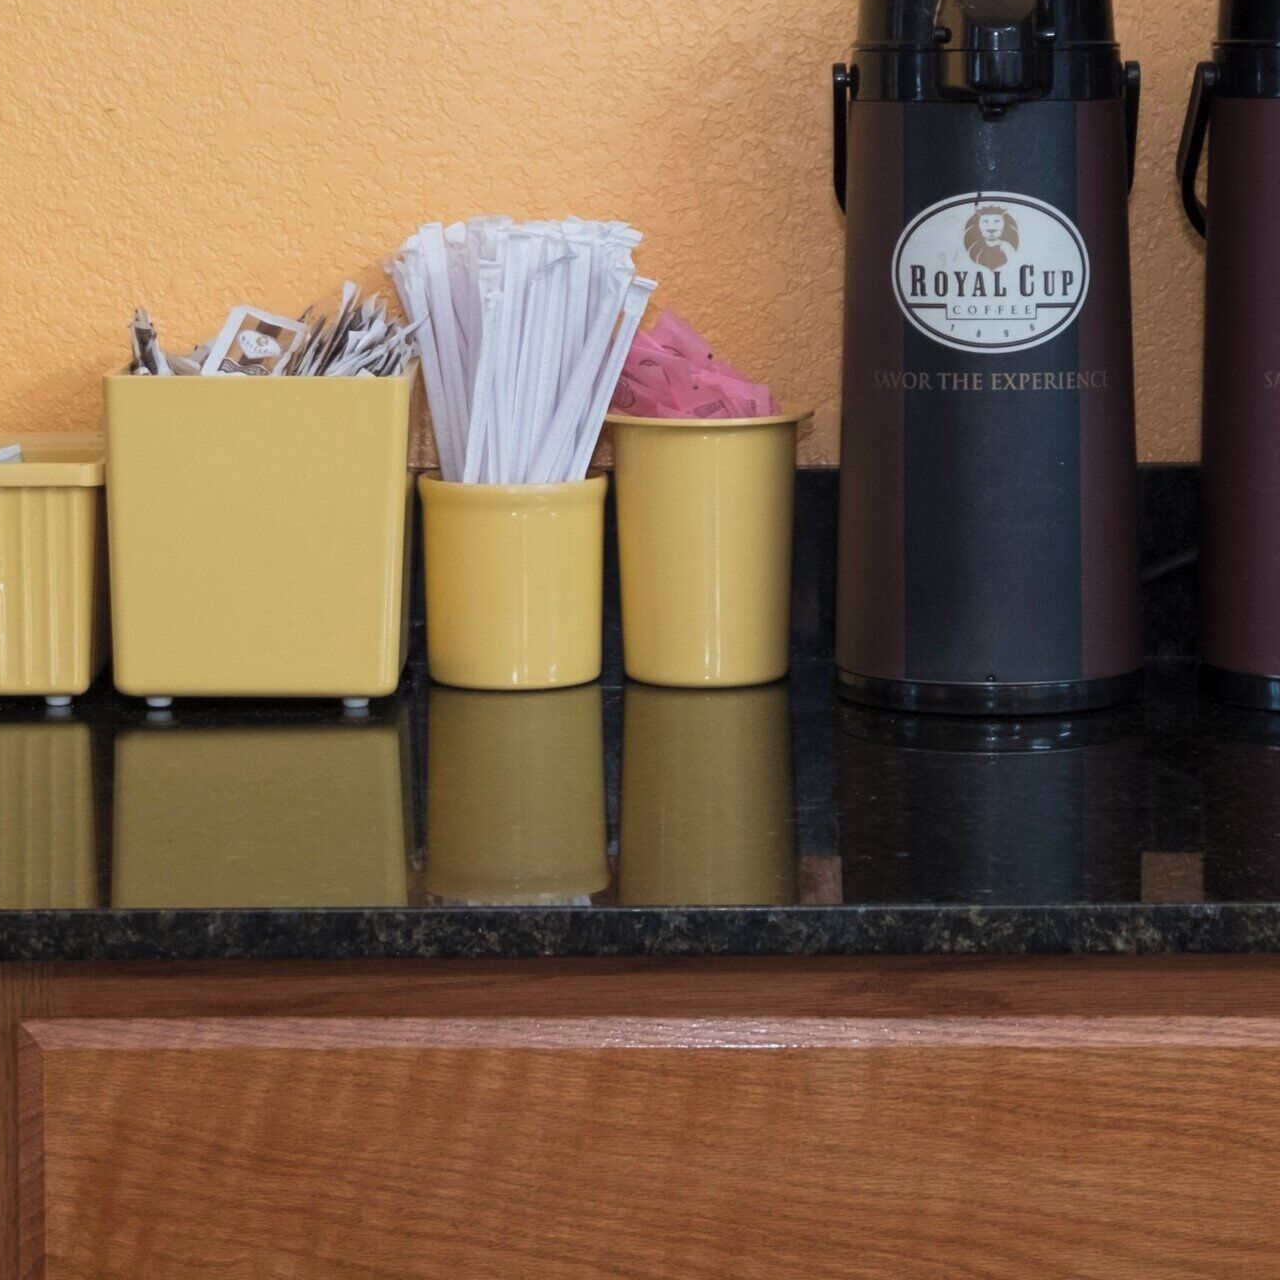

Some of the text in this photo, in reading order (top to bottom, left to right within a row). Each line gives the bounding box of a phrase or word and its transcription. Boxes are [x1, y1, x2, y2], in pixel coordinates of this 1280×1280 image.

[910, 264, 1074, 297] ROYAL CUP
[952, 304, 1032, 315] COFFEE
[873, 371, 1109, 391] SAVOR THE EXPERIENCE
